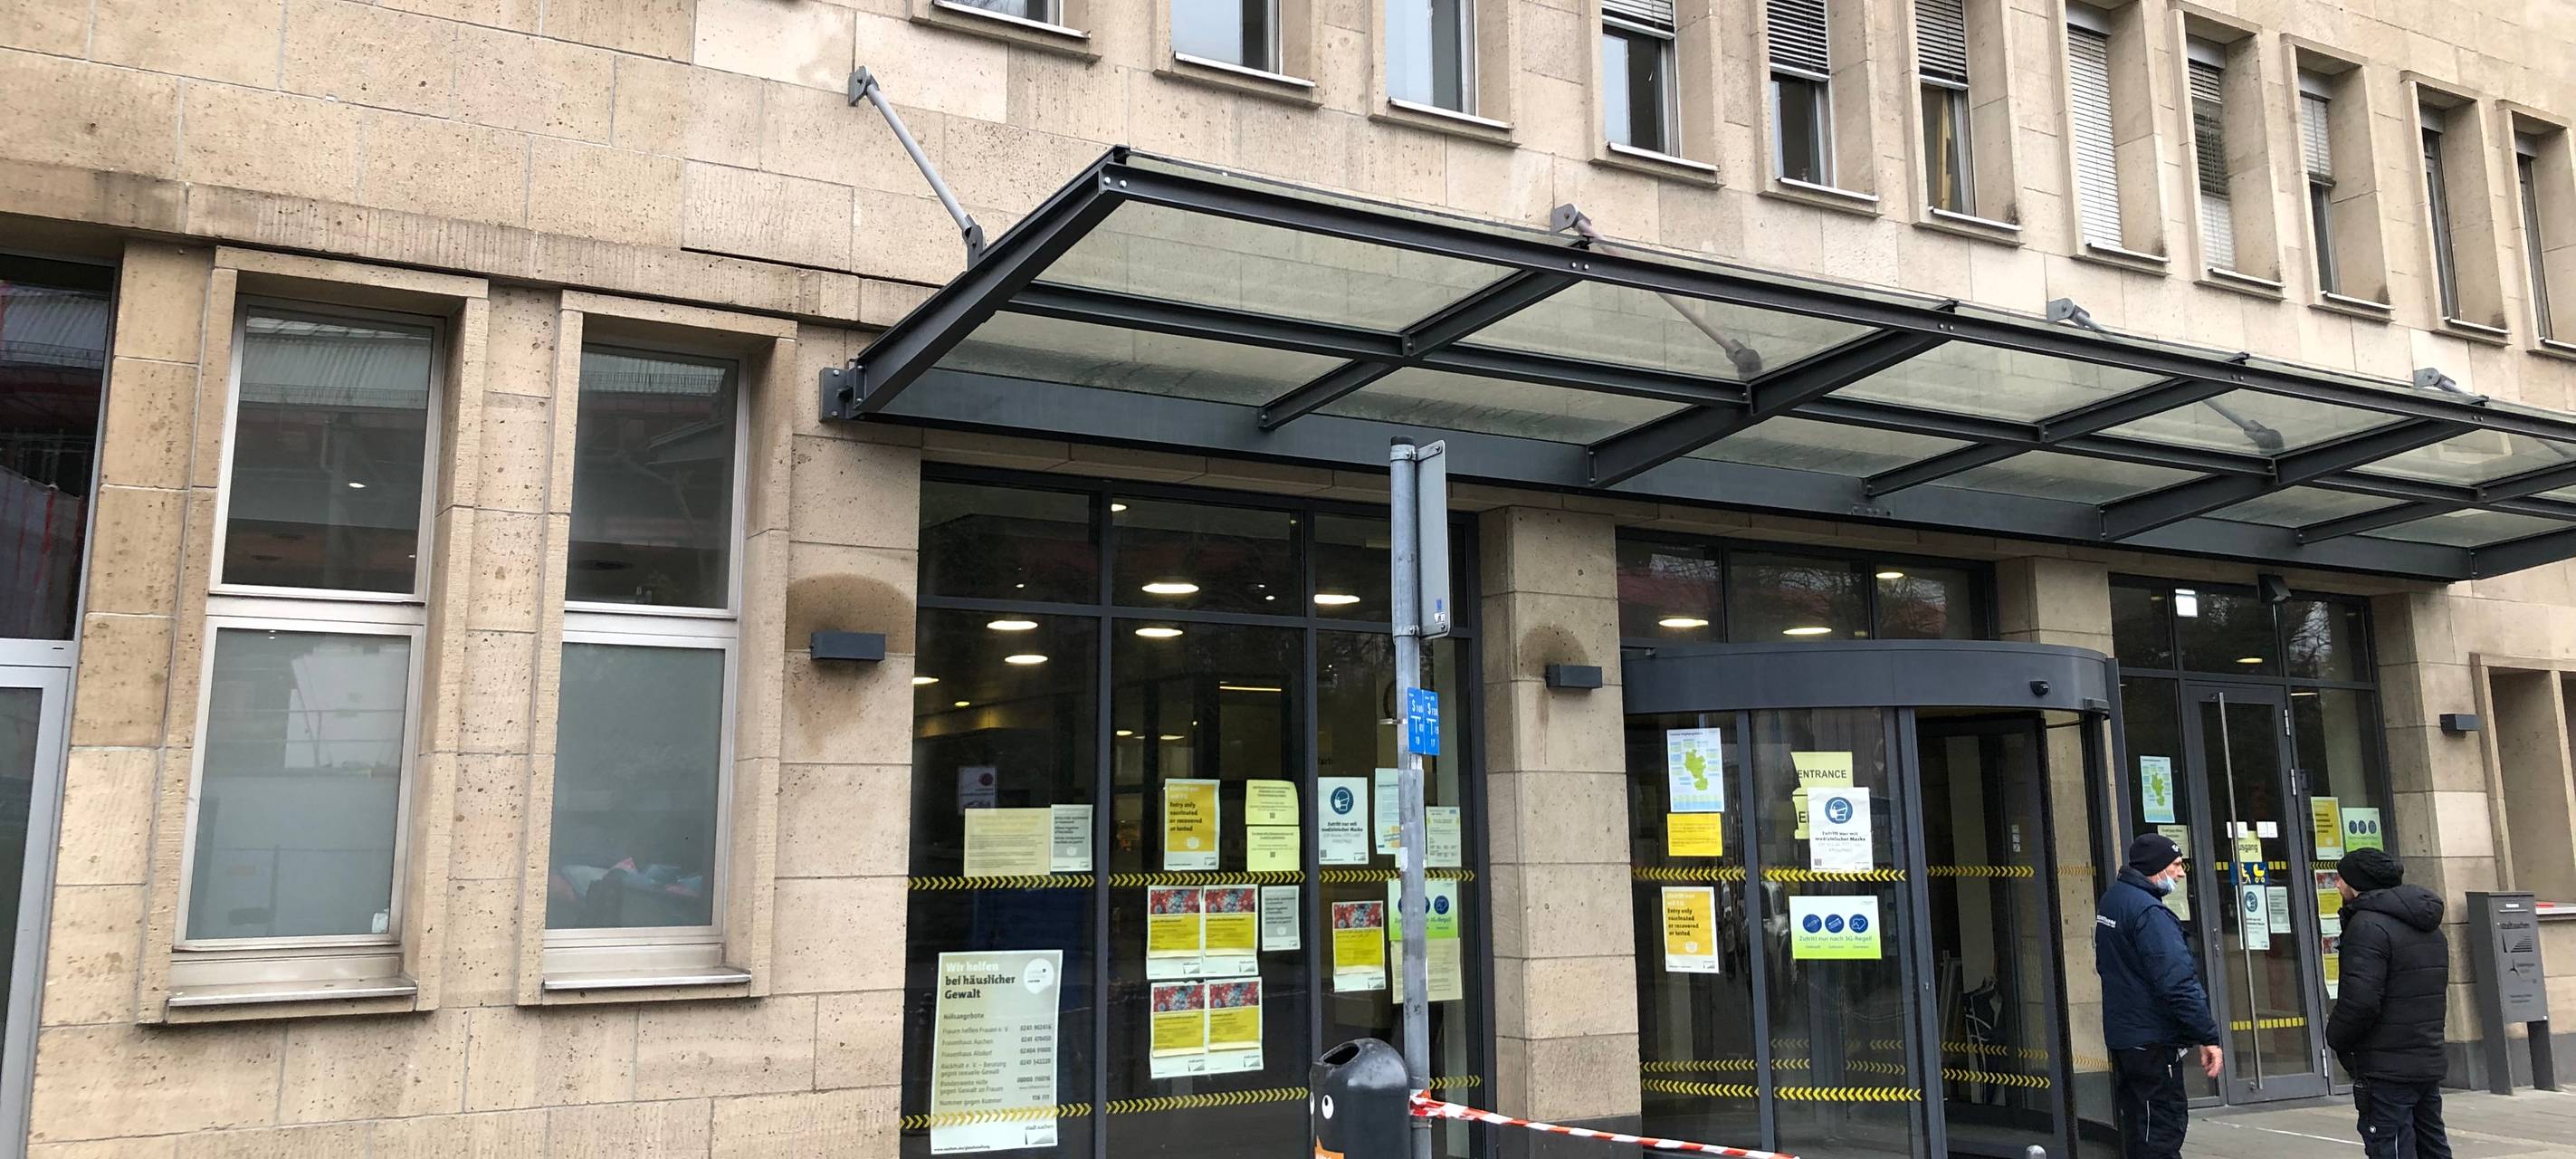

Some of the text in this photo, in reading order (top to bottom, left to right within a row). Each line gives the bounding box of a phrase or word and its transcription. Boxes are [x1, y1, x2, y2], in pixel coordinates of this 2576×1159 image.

[1798, 770, 1846, 779] ENTRANCE
[946, 961, 998, 972] Wir helfen
[945, 974, 1016, 985] bei häuslicher
[944, 988, 981, 999] Gewalt
